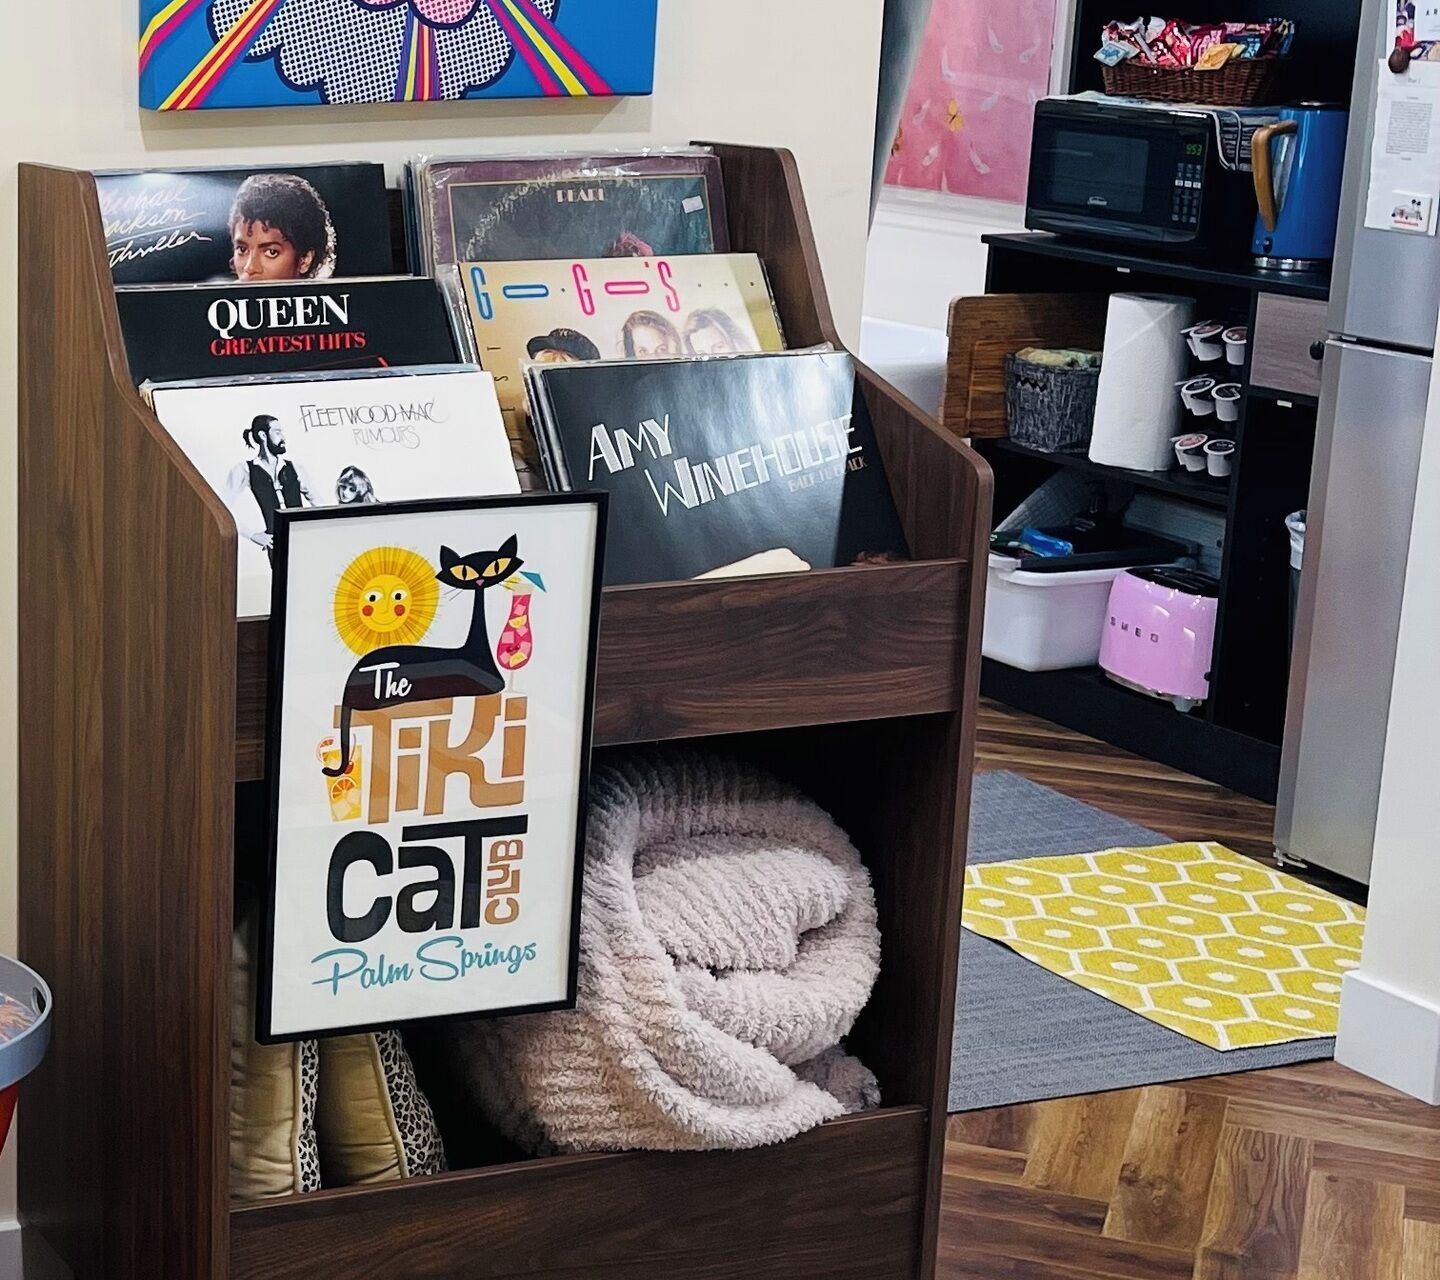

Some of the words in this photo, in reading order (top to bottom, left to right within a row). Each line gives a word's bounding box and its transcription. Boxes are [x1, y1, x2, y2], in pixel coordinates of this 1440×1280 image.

[556, 185, 609, 203] PEARL
[103, 206, 207, 238] ackson
[107, 229, 213, 269] Thriller
[207, 293, 350, 340] QUEEN
[210, 333, 317, 357] GREATEST
[318, 331, 368, 352] HITS
[352, 425, 421, 451] RUMOURS
[588, 413, 673, 481] AMY
[644, 413, 863, 517] WINEHOUSE
[833, 455, 870, 478] BACK
[359, 661, 413, 700] The
[484, 838, 524, 926] CLUB
[310, 946, 414, 996] Palm
[416, 935, 537, 982] Springs
